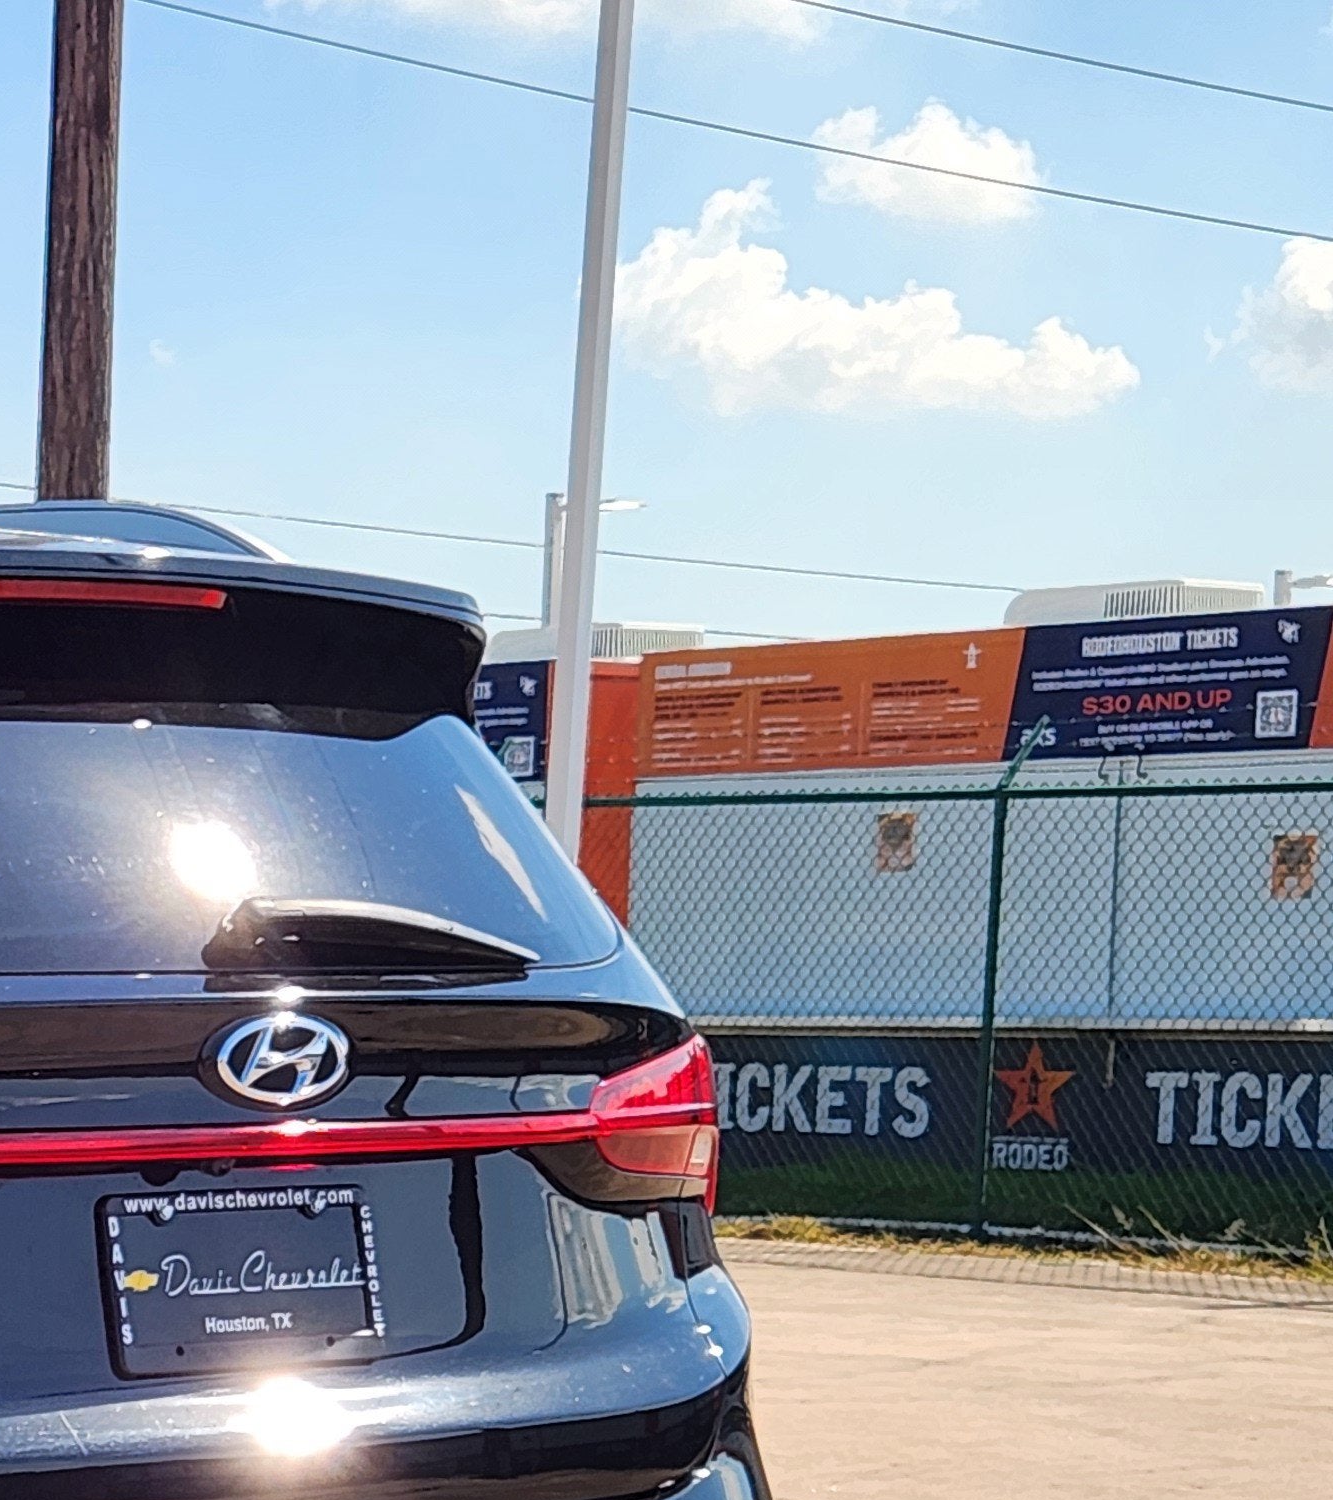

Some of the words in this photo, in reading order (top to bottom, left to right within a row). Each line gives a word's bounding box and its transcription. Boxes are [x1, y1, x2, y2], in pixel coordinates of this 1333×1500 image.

[1136, 691, 1192, 713] AND
[1196, 689, 1233, 709] UP
[992, 1142, 1069, 1171] RODEO
[124, 1188, 354, 1213] wwwdavischevroletcom
[108, 1216, 133, 1346] DAVIS
[161, 1253, 240, 1297] Davis
[240, 1250, 365, 1293] Chevrolet
[360, 1205, 386, 1338] CHEVROLET
[205, 1315, 269, 1334] Houston,
[271, 1312, 293, 1329] TX
